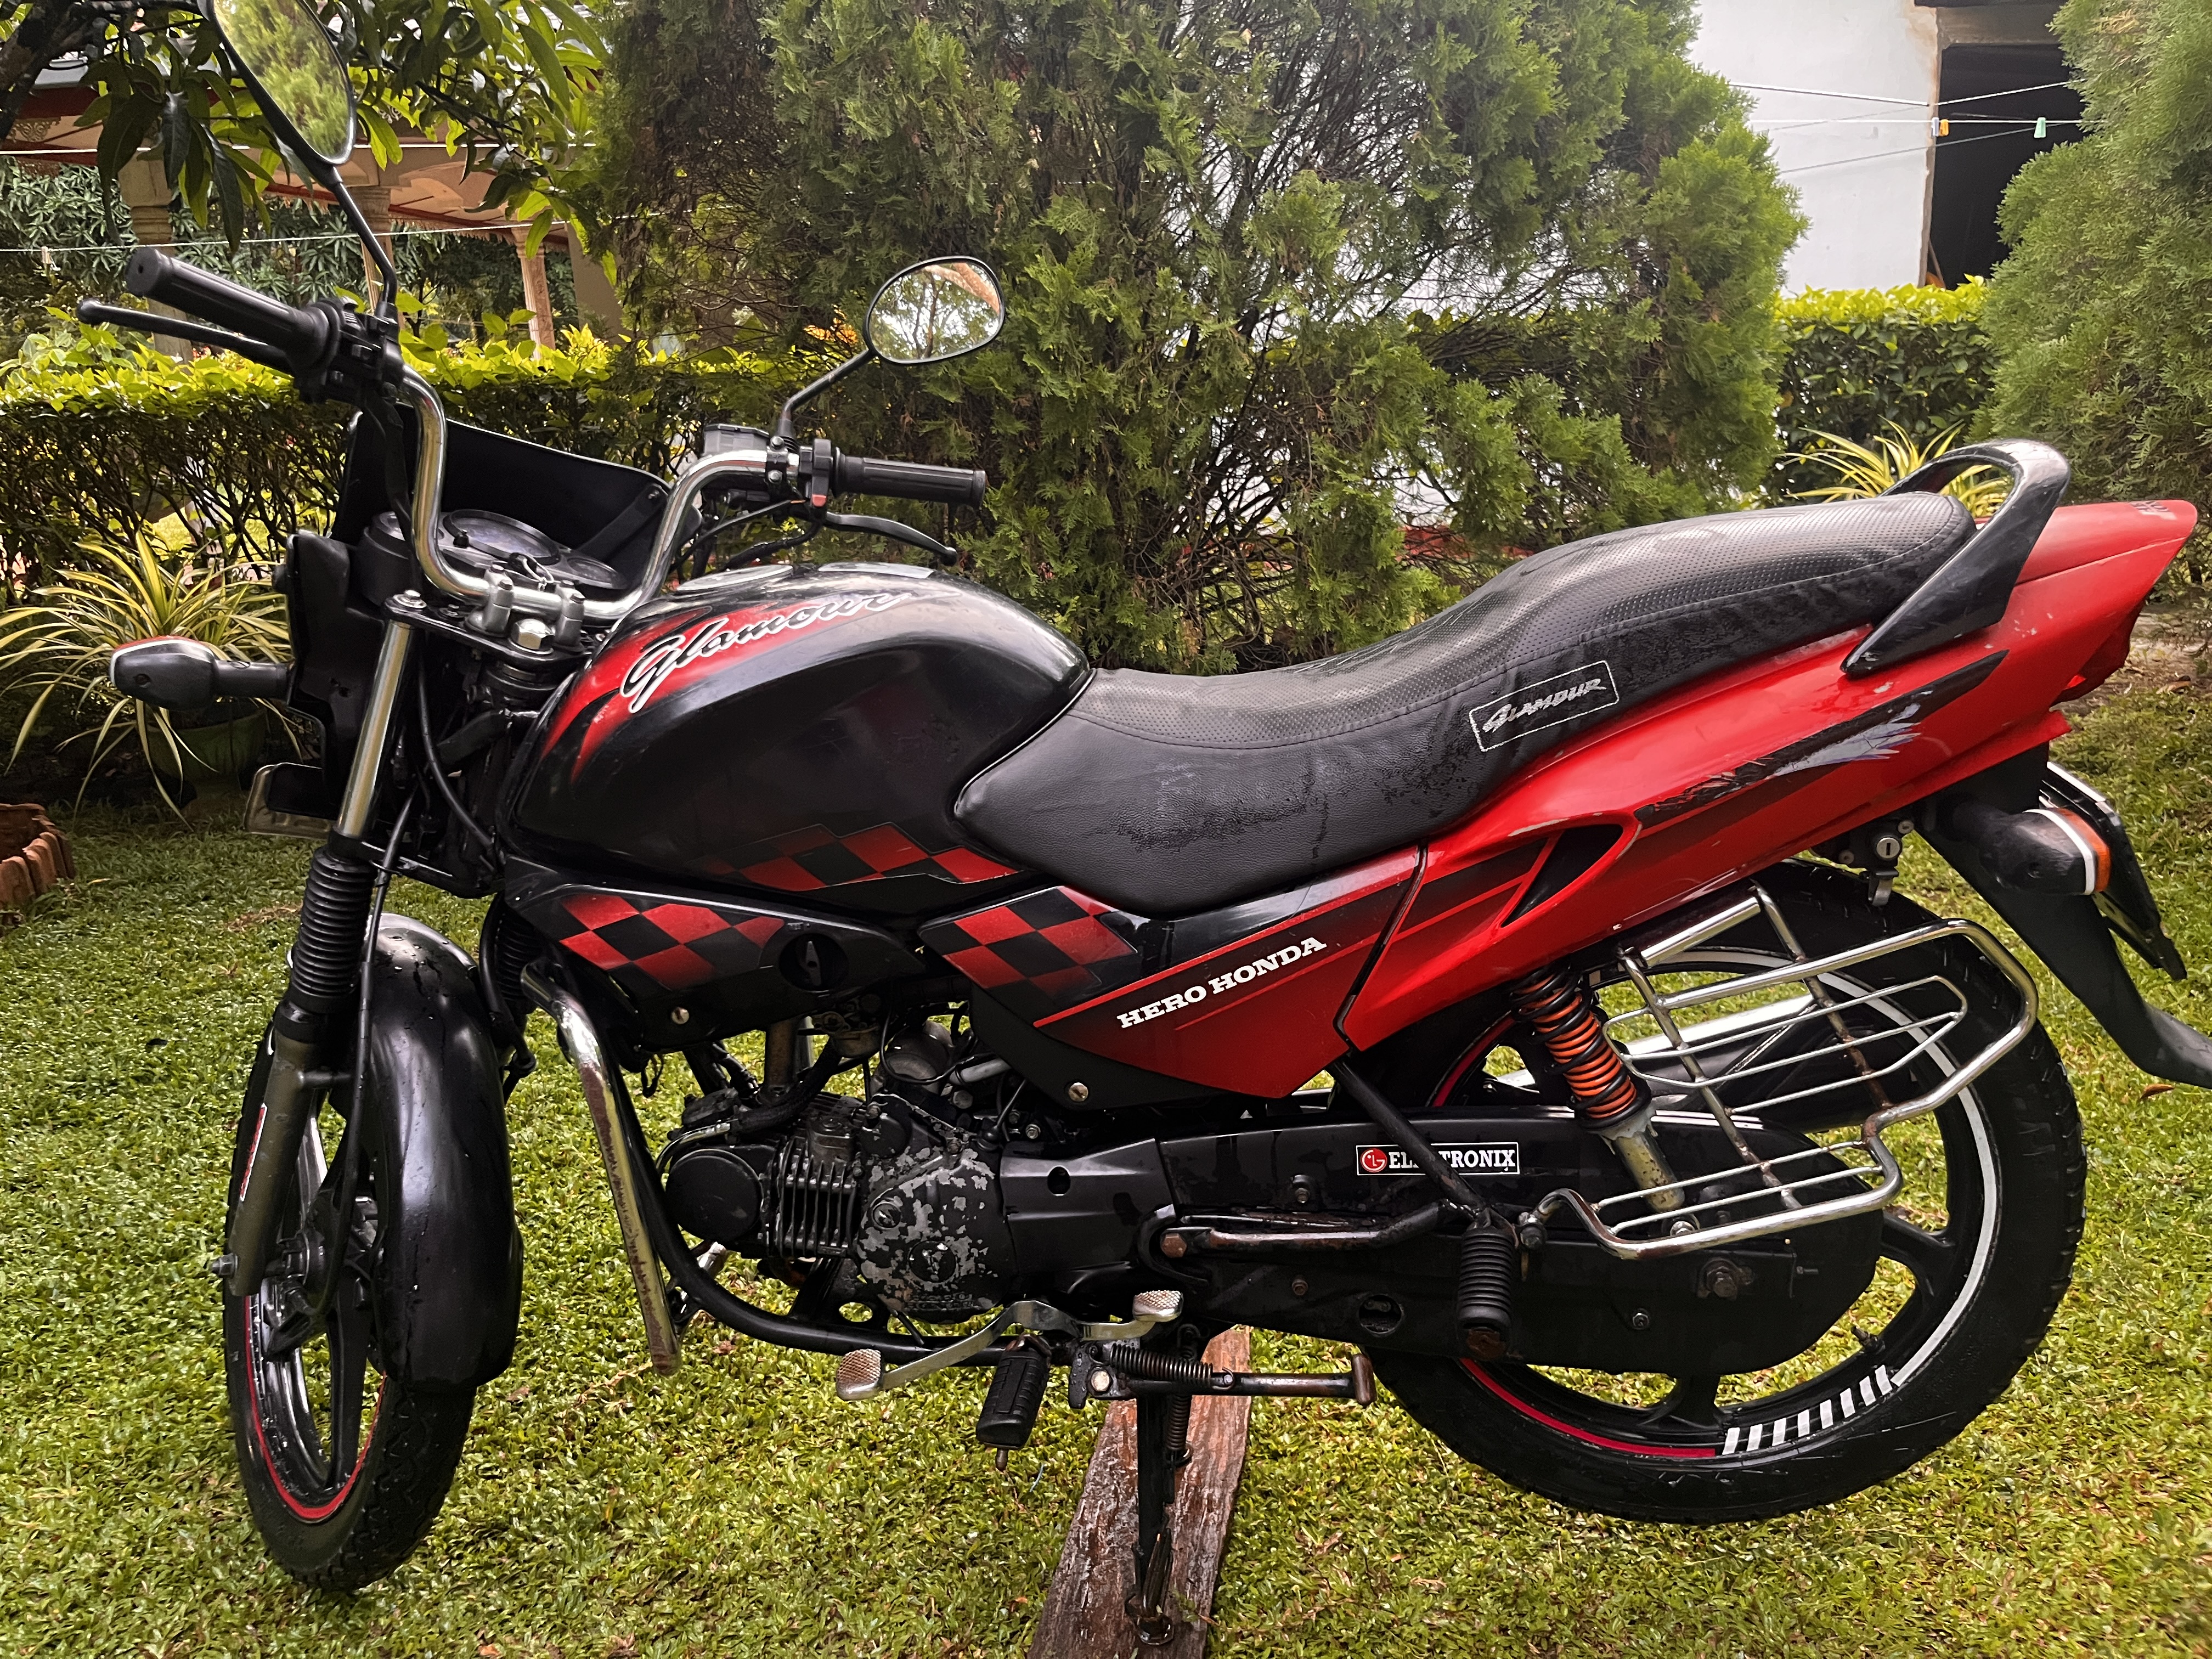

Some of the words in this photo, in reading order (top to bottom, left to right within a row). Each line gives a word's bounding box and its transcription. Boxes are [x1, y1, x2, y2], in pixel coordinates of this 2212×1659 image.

[1116, 985, 1207, 1028] HERO
[1207, 937, 1327, 994] HONDA
[1388, 1150, 1516, 1169] ELTRONIX
